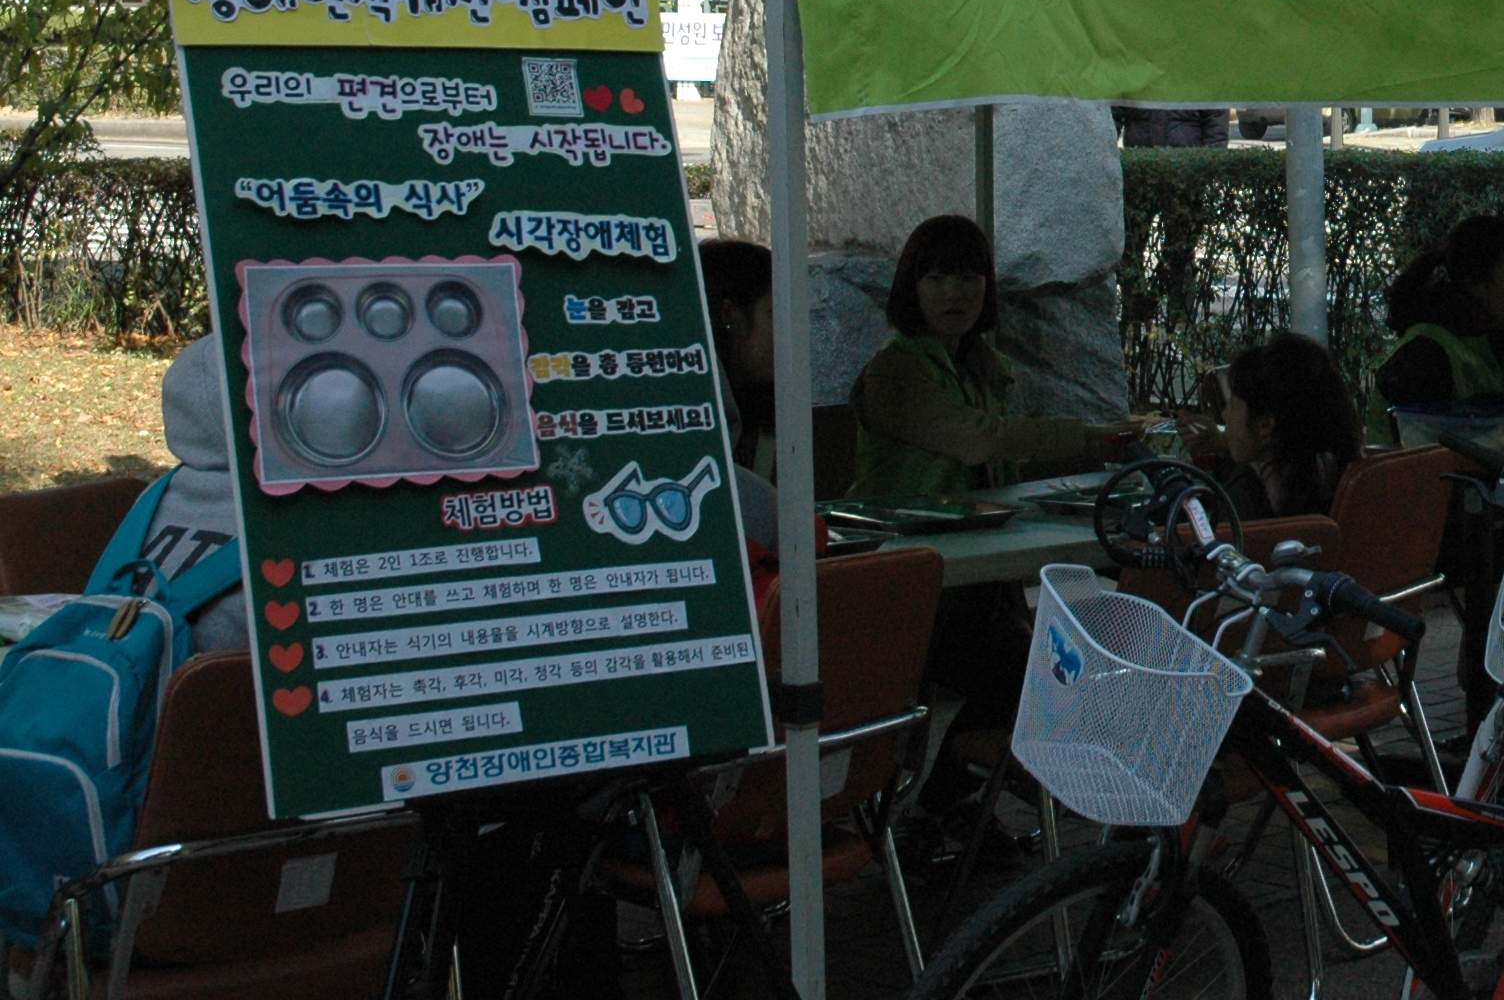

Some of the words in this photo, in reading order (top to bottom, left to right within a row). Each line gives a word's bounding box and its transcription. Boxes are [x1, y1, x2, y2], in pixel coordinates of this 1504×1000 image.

[228, 72, 312, 105] 우리의
[337, 75, 494, 117] 편견으로부터
[424, 126, 511, 162] 장애는
[529, 125, 668, 163] 시작됩니다.
[494, 216, 671, 258] 시각장애체험
[566, 297, 607, 321] 눈을
[616, 298, 656, 321] 감고
[529, 353, 591, 379] 감각을
[599, 350, 619, 376] 총
[626, 349, 704, 375] 동원하여
[537, 411, 598, 438] 음식을
[606, 406, 712, 432] 드셔보세요!
[444, 488, 553, 528] 체험방법
[324, 558, 370, 578] 체험은
[378, 554, 401, 572] 2인
[410, 551, 448, 568] 1조로
[456, 542, 533, 564] 진행합니다.
[329, 599, 345, 616] 한
[353, 595, 383, 614] 명은
[392, 589, 437, 609] 안대를
[446, 586, 476, 604] 쓰고
[483, 579, 541, 600] 체험하며
[548, 575, 562, 594] 한
[569, 573, 598, 592] 명은
[606, 569, 659, 589] 안내자가
[666, 565, 710, 584] 됩니다.
[315, 644, 328, 661] 3.
[335, 639, 399, 661] 안내자는
[407, 632, 452, 652] 식기의
[460, 625, 518, 647] 내용물을
[527, 617, 612, 639] 시계방향으로
[620, 609, 679, 631] 설명한다.
[320, 688, 334, 704] 4.
[341, 682, 403, 704] 체험자는
[412, 676, 447, 695] 촉각,
[453, 672, 487, 690] 후각,
[494, 667, 528, 685] 미각,
[534, 663, 562, 682] 청각
[569, 659, 598, 678] 등의
[604, 653, 646, 674] 감각을
[651, 646, 703, 668] 활용해서
[711, 641, 750, 660] 준비된
[352, 724, 399, 746] 음식을
[408, 717, 453, 738] 드시면
[461, 711, 511, 732] 됩니다.
[425, 732, 677, 787] 양천장애인종합복지관
[1285, 790, 1400, 927] LESPO
